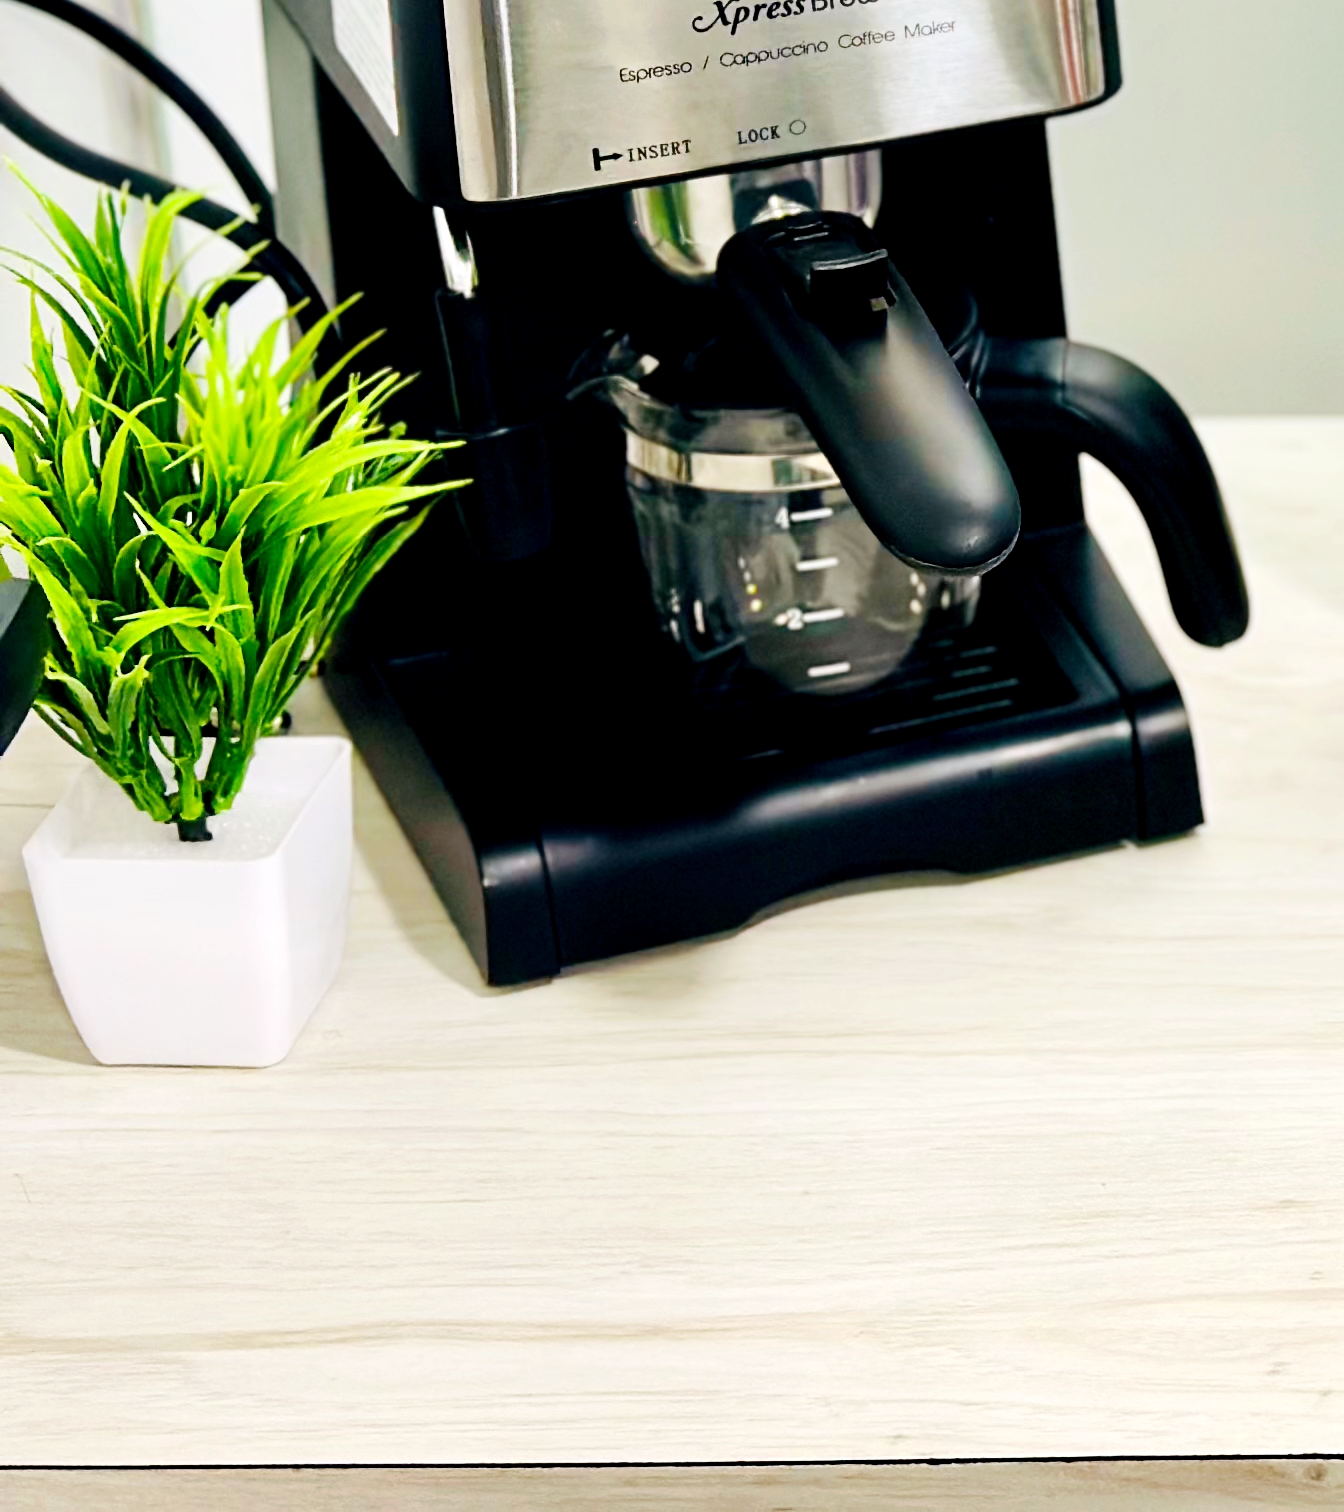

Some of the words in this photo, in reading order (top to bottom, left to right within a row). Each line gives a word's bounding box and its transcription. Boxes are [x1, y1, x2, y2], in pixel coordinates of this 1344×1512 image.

[619, 60, 692, 83] Espresso
[720, 40, 829, 68] Cappuccino
[838, 29, 896, 49] Coffee
[904, 20, 957, 40] Maker
[737, 125, 780, 145] LOCK
[627, 140, 692, 162] INSERT
[775, 506, 789, 529] 4
[787, 607, 804, 630] 2
